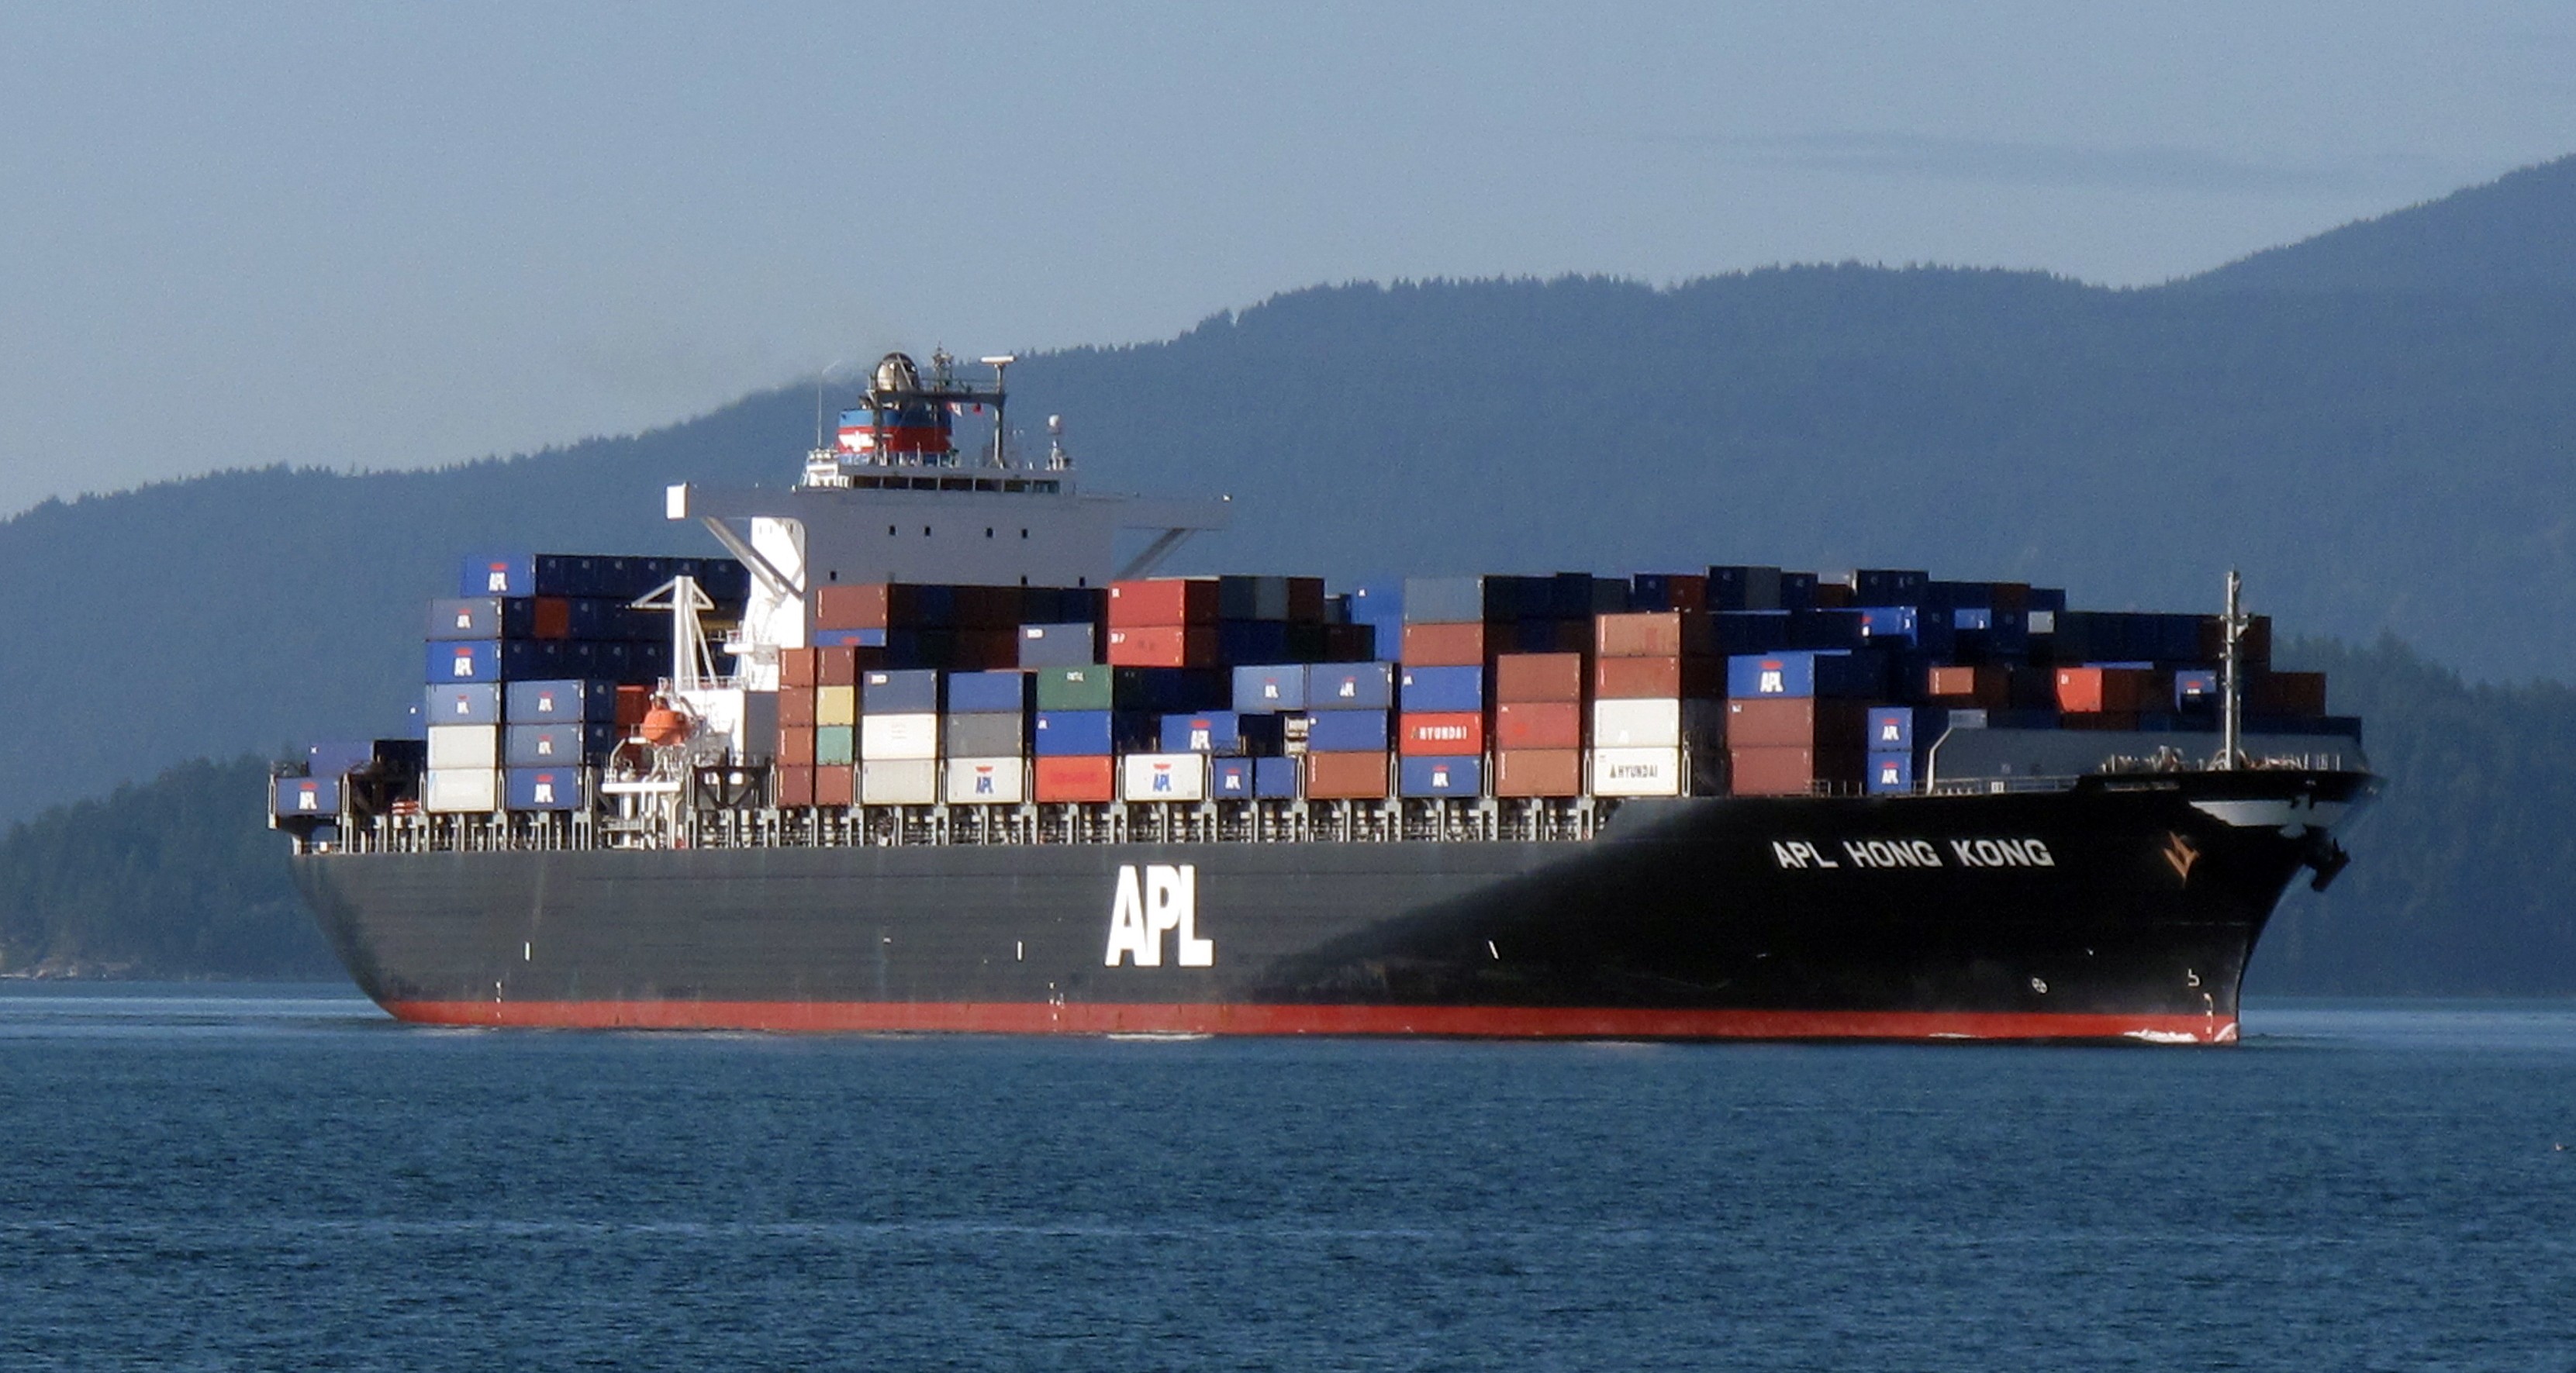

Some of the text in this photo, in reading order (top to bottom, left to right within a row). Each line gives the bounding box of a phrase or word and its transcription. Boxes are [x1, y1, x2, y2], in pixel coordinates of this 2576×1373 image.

[1760, 671, 1784, 692] APL
[1419, 726, 1467, 740] HYUNDAI
[1618, 764, 1658, 778] HYUNDAI
[1772, 839, 2055, 868] APL HONG KONG
[1105, 864, 1214, 967] APL
